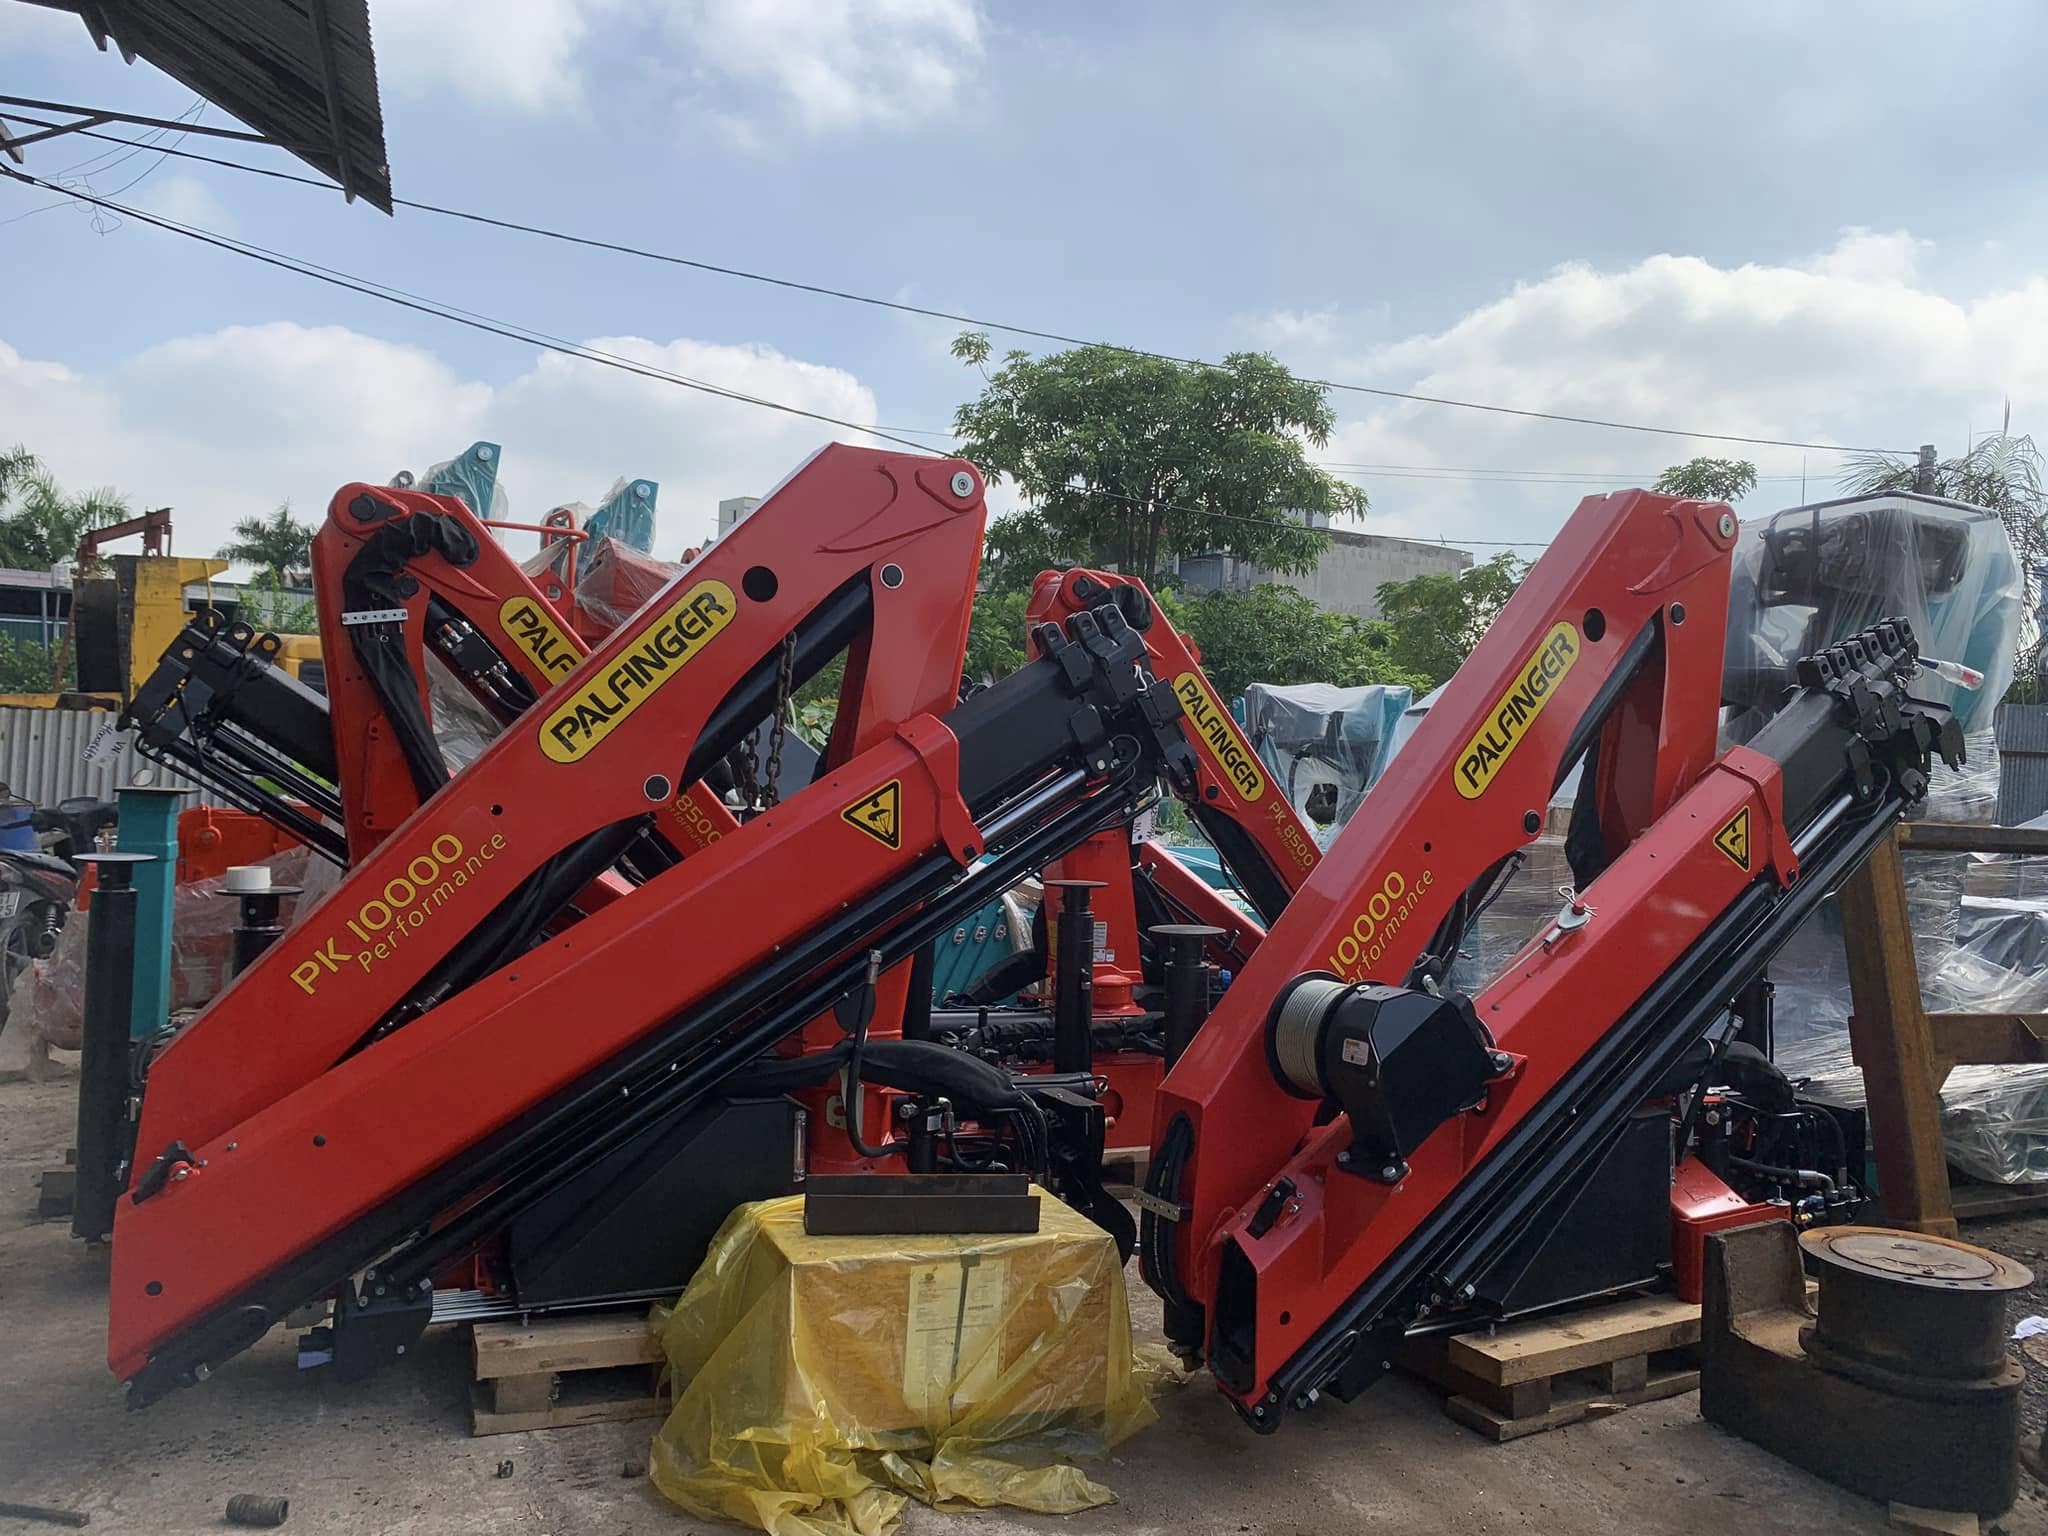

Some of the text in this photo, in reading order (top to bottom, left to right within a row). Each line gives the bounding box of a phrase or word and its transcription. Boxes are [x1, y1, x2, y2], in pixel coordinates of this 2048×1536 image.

[550, 592, 728, 754] PALFINGER
[1177, 679, 1260, 796] PALFINGER
[1461, 632, 1573, 790] PALFINGER
[357, 833, 507, 973] Performance
[1268, 801, 1315, 867] PK 8500
[290, 834, 463, 996] PK 10000
[1329, 871, 1406, 978] 10000
